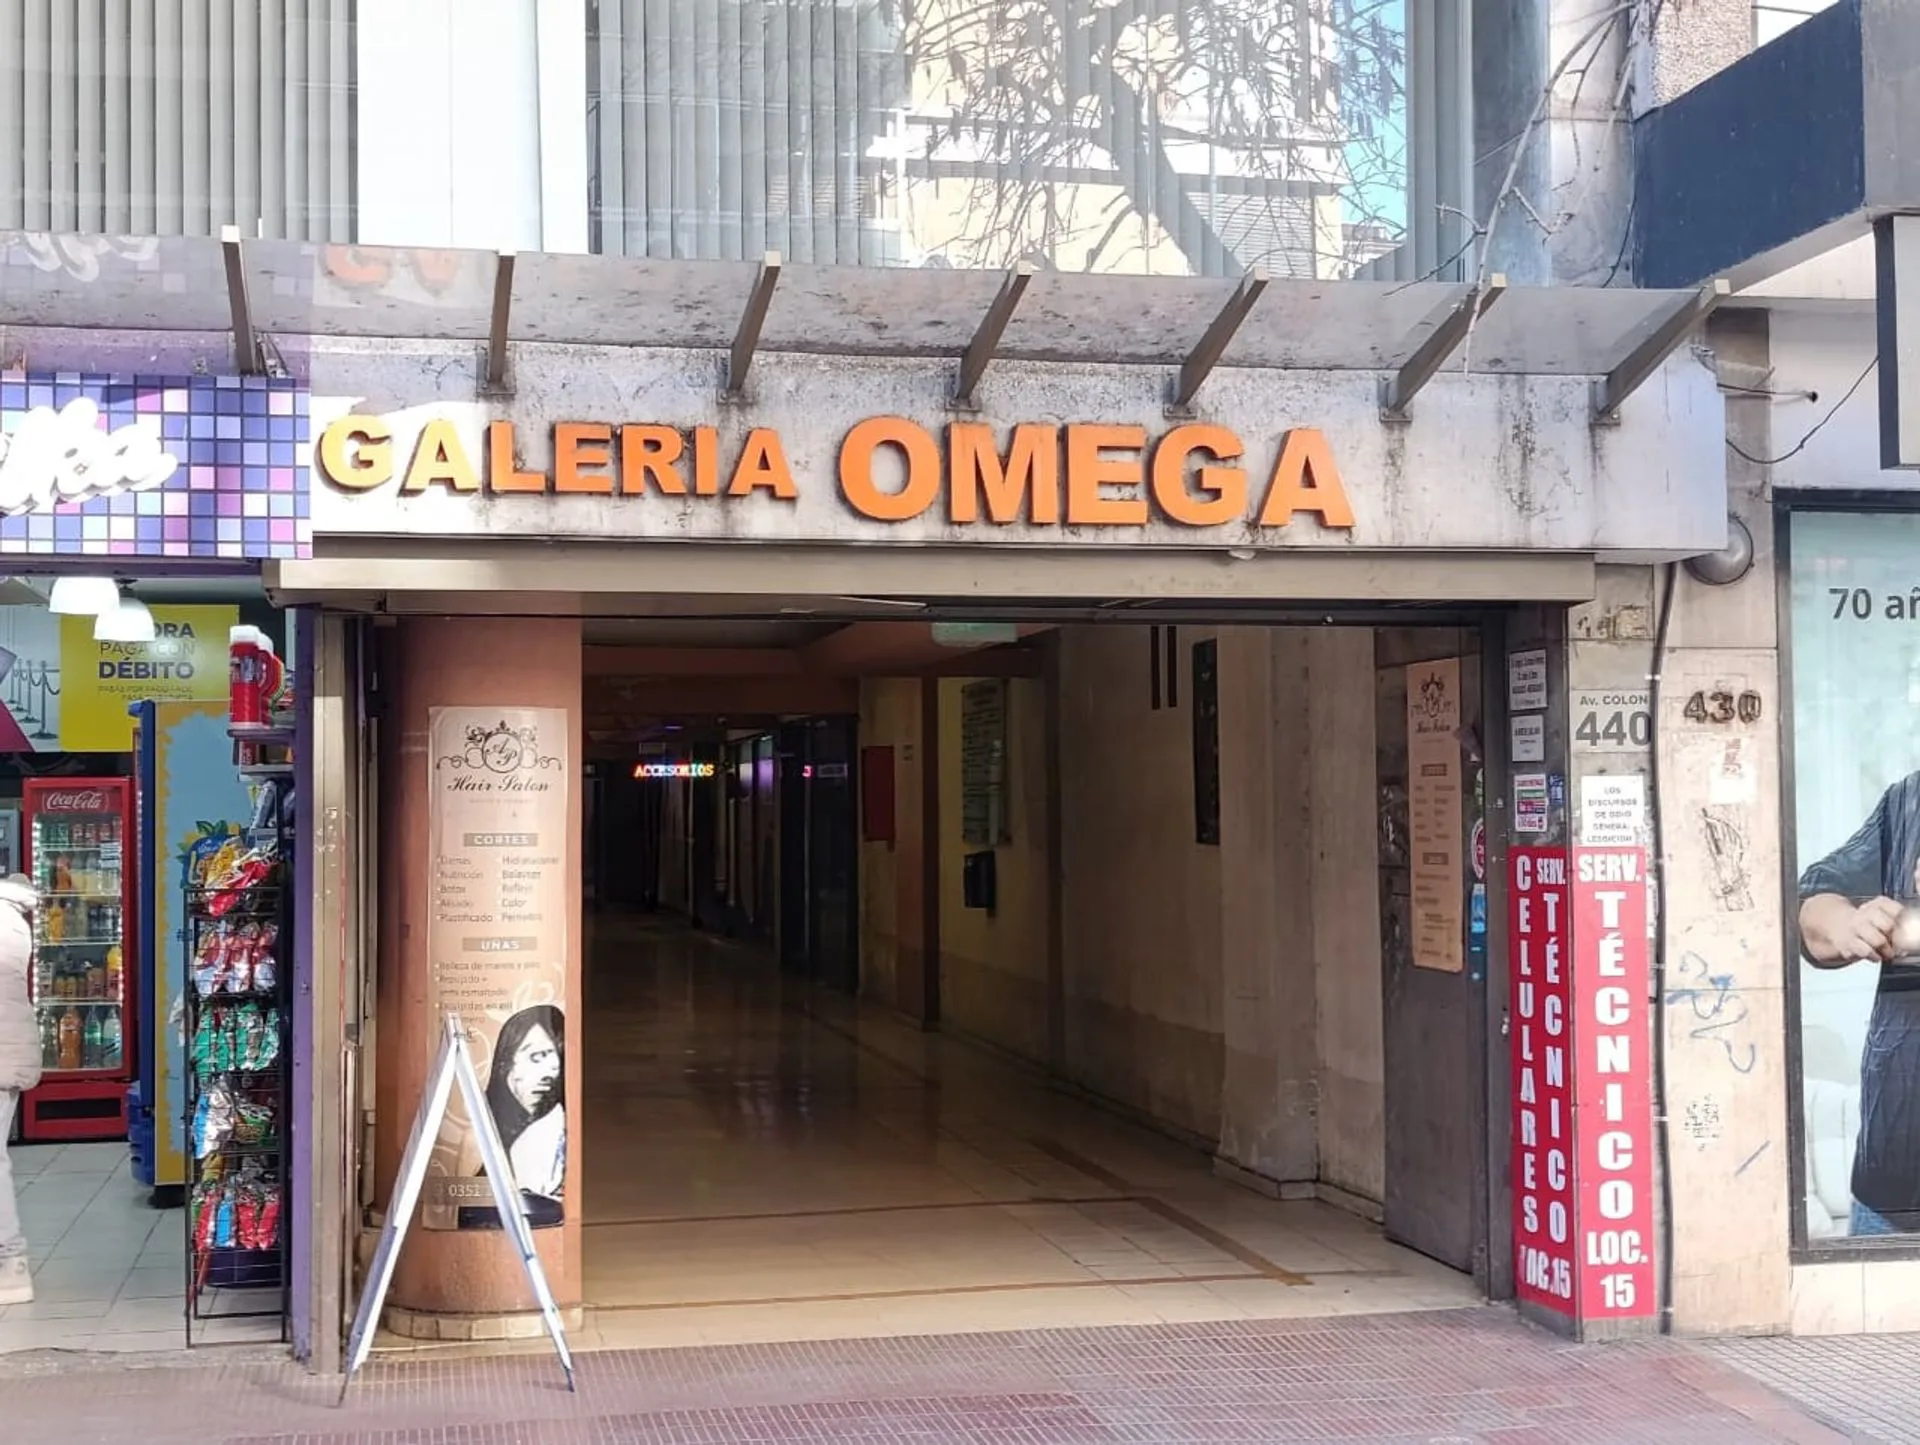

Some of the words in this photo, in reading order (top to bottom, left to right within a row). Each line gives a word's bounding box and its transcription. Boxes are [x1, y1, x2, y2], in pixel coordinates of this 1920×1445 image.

[318, 414, 798, 500] GALERIA
[839, 415, 1356, 528] OMEGA
[1828, 588, 1872, 620] 70
[99, 657, 194, 679] DÉBITO
[1602, 694, 1648, 705] COLON
[1683, 690, 1763, 724] 430
[1576, 711, 1651, 746] 440
[447, 775, 492, 792] Hair
[633, 763, 715, 779] ACCESORIOS
[1536, 857, 1566, 885] SERV.
[1578, 854, 1642, 882] SERV.
[1516, 855, 1539, 1233] CELULARES
[1594, 891, 1634, 1219] TÉCNICO
[1543, 892, 1567, 1243] TÉCNICO
[1586, 1230, 1648, 1266] LOC.
[1600, 1274, 1636, 1308] 15
